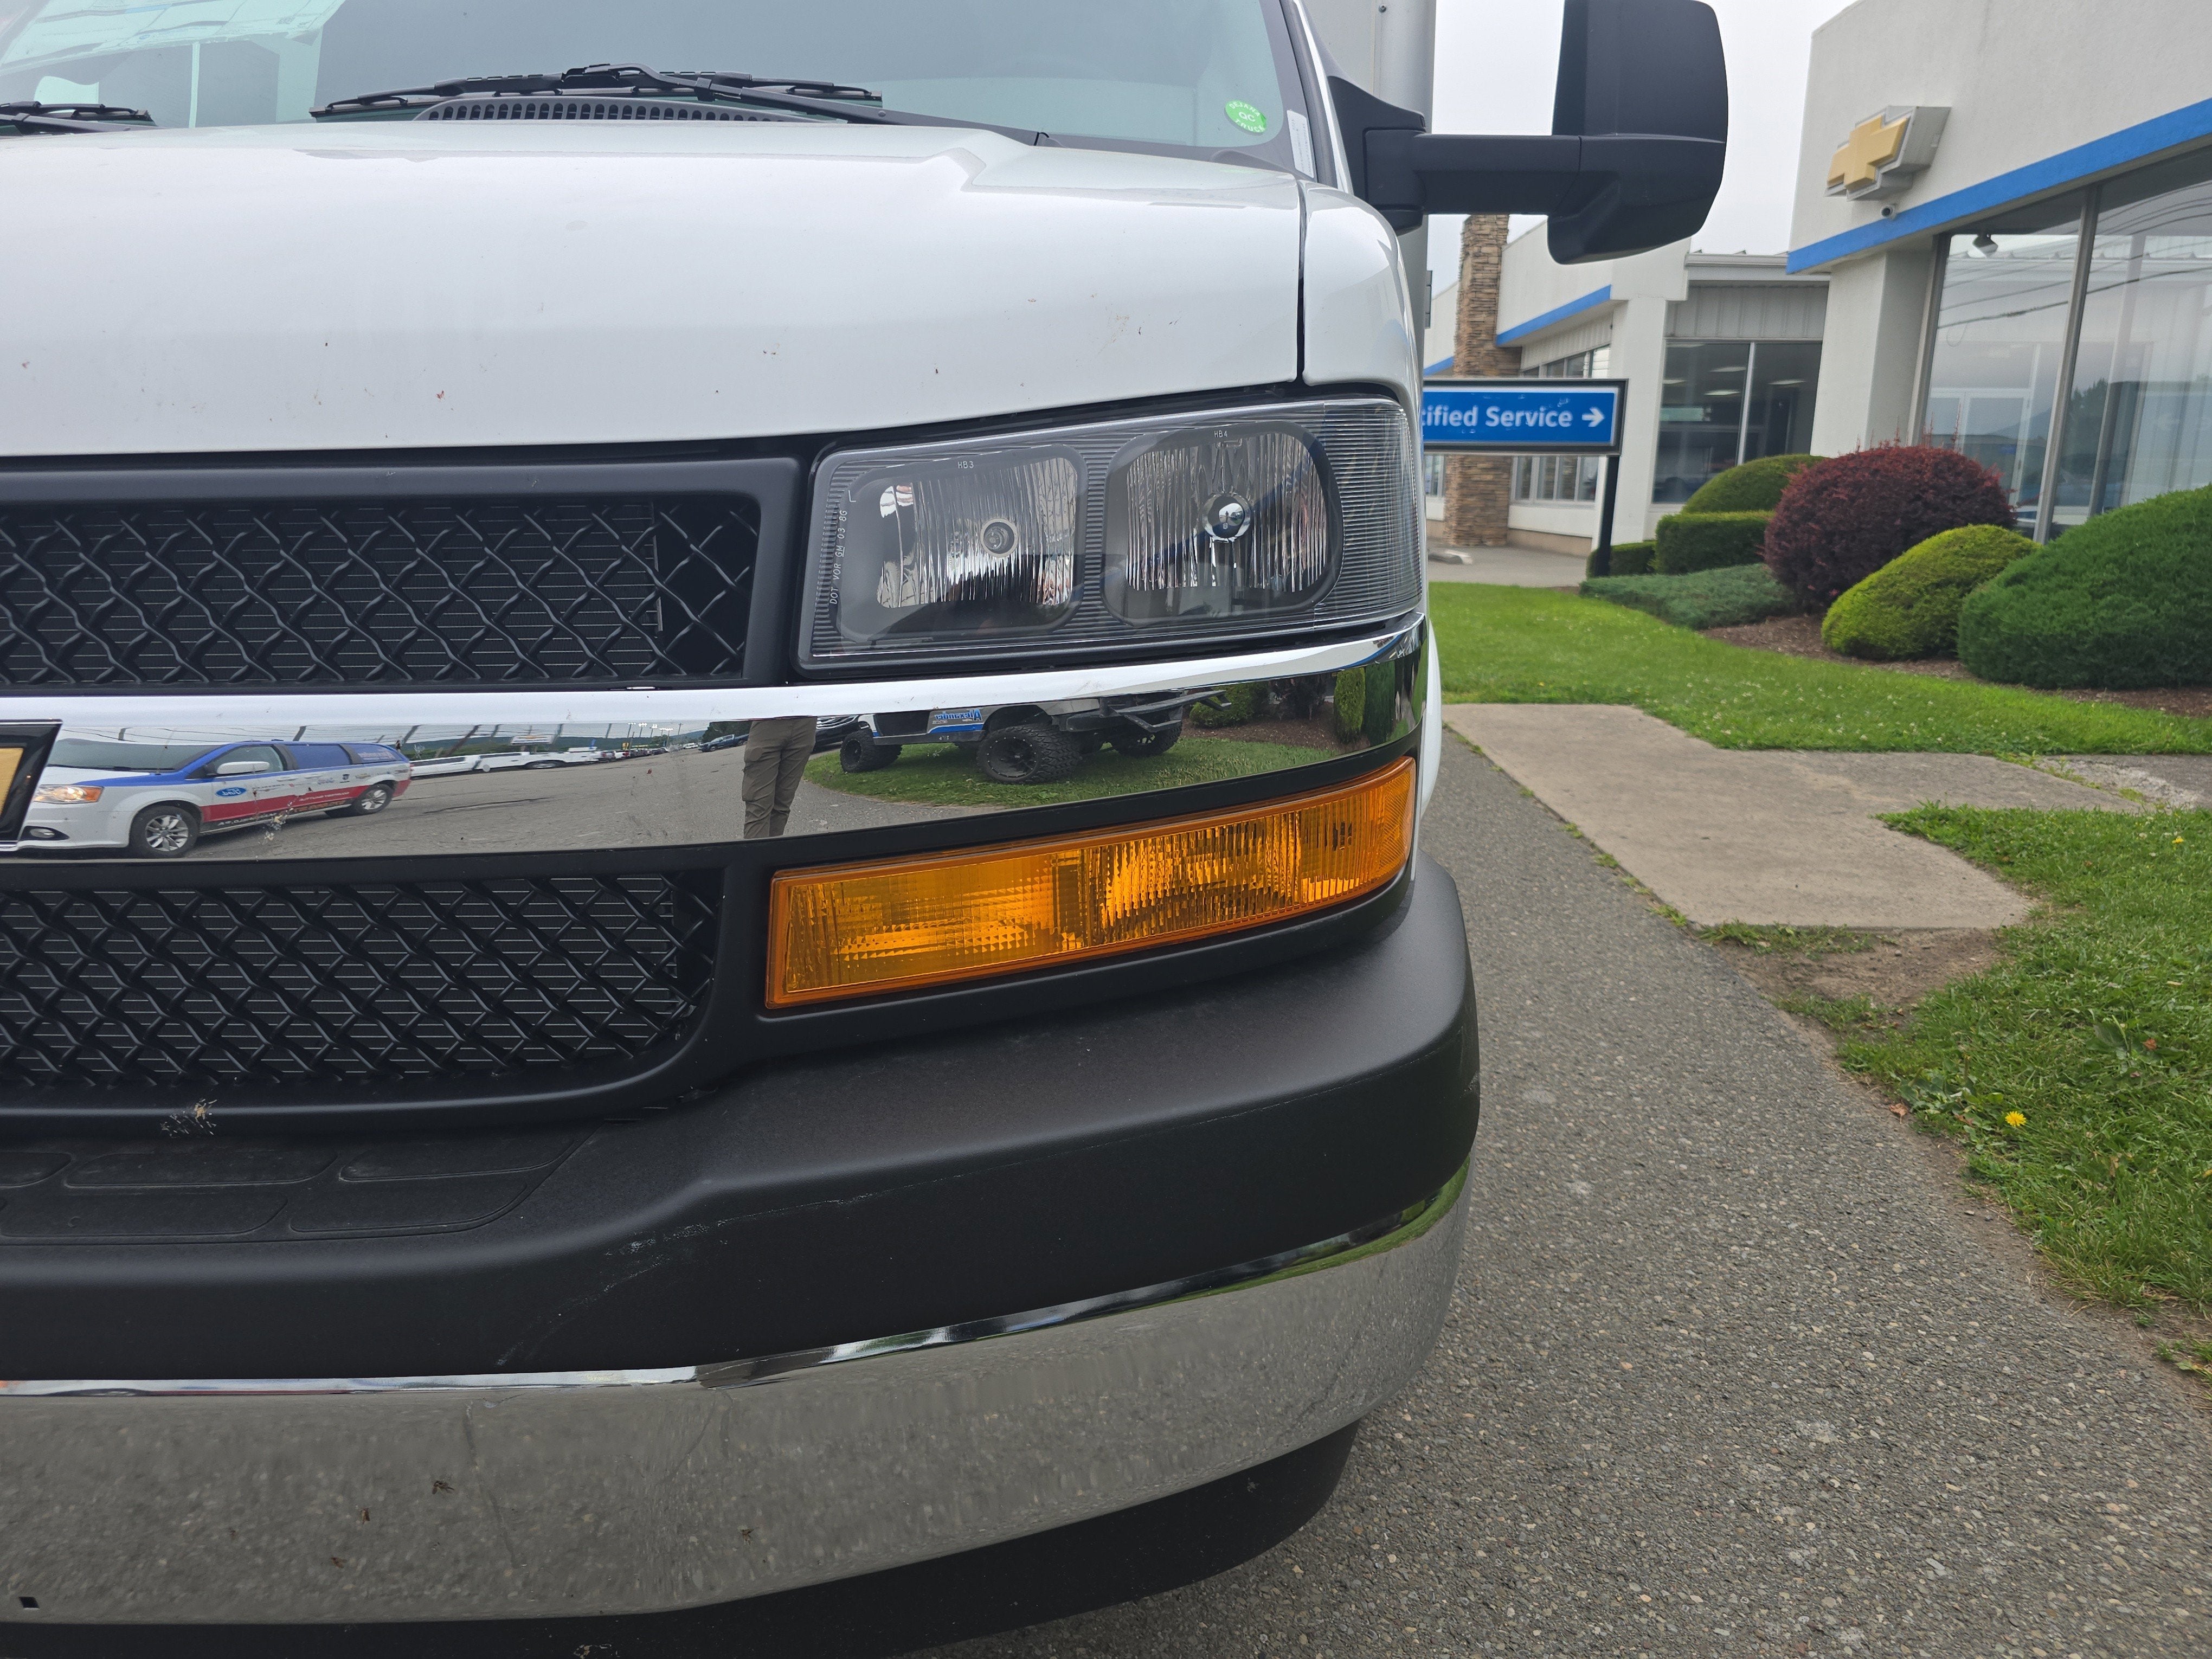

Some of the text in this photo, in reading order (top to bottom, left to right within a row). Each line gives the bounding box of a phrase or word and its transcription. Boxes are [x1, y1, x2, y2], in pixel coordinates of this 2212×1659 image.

[1238, 112, 1256, 122] QC
[1235, 119, 1265, 132] TRUCK
[1486, 406, 1572, 427] Service
[1214, 430, 1228, 438] HB4
[957, 460, 974, 469] HB3
[837, 528, 846, 539] 03
[835, 545, 845, 557] GM
[832, 563, 842, 581] VOR
[829, 586, 839, 605] DOT
